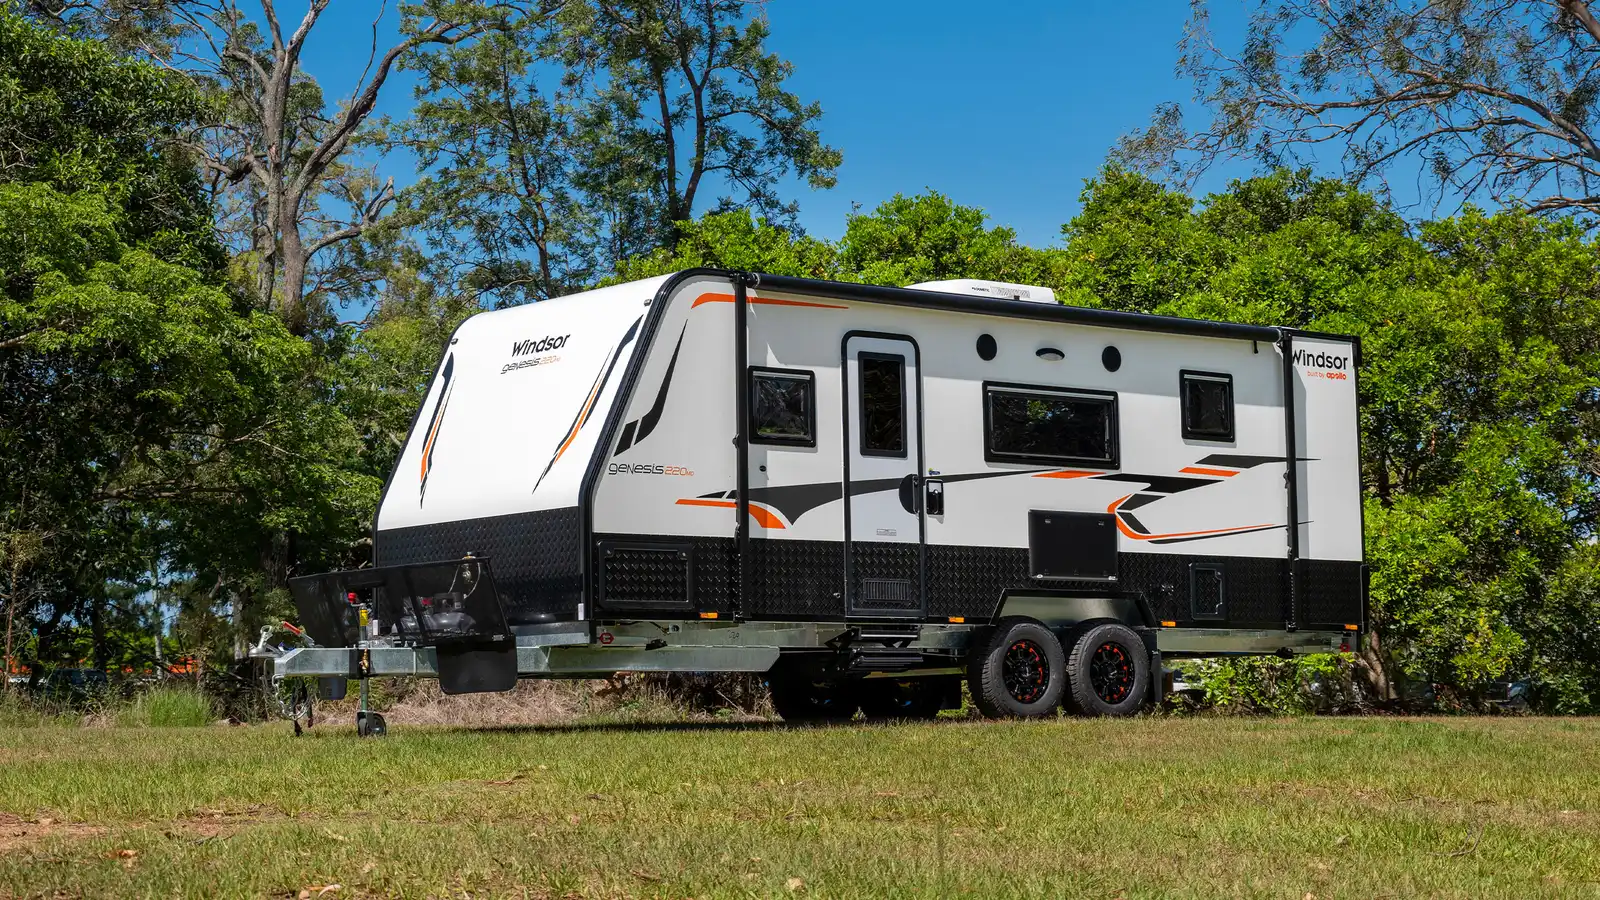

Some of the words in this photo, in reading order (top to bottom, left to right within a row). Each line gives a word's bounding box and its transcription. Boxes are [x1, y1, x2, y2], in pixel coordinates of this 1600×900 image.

[511, 334, 571, 357] Windsor
[1292, 349, 1349, 370] Windsor
[1326, 372, 1347, 380] apollo
